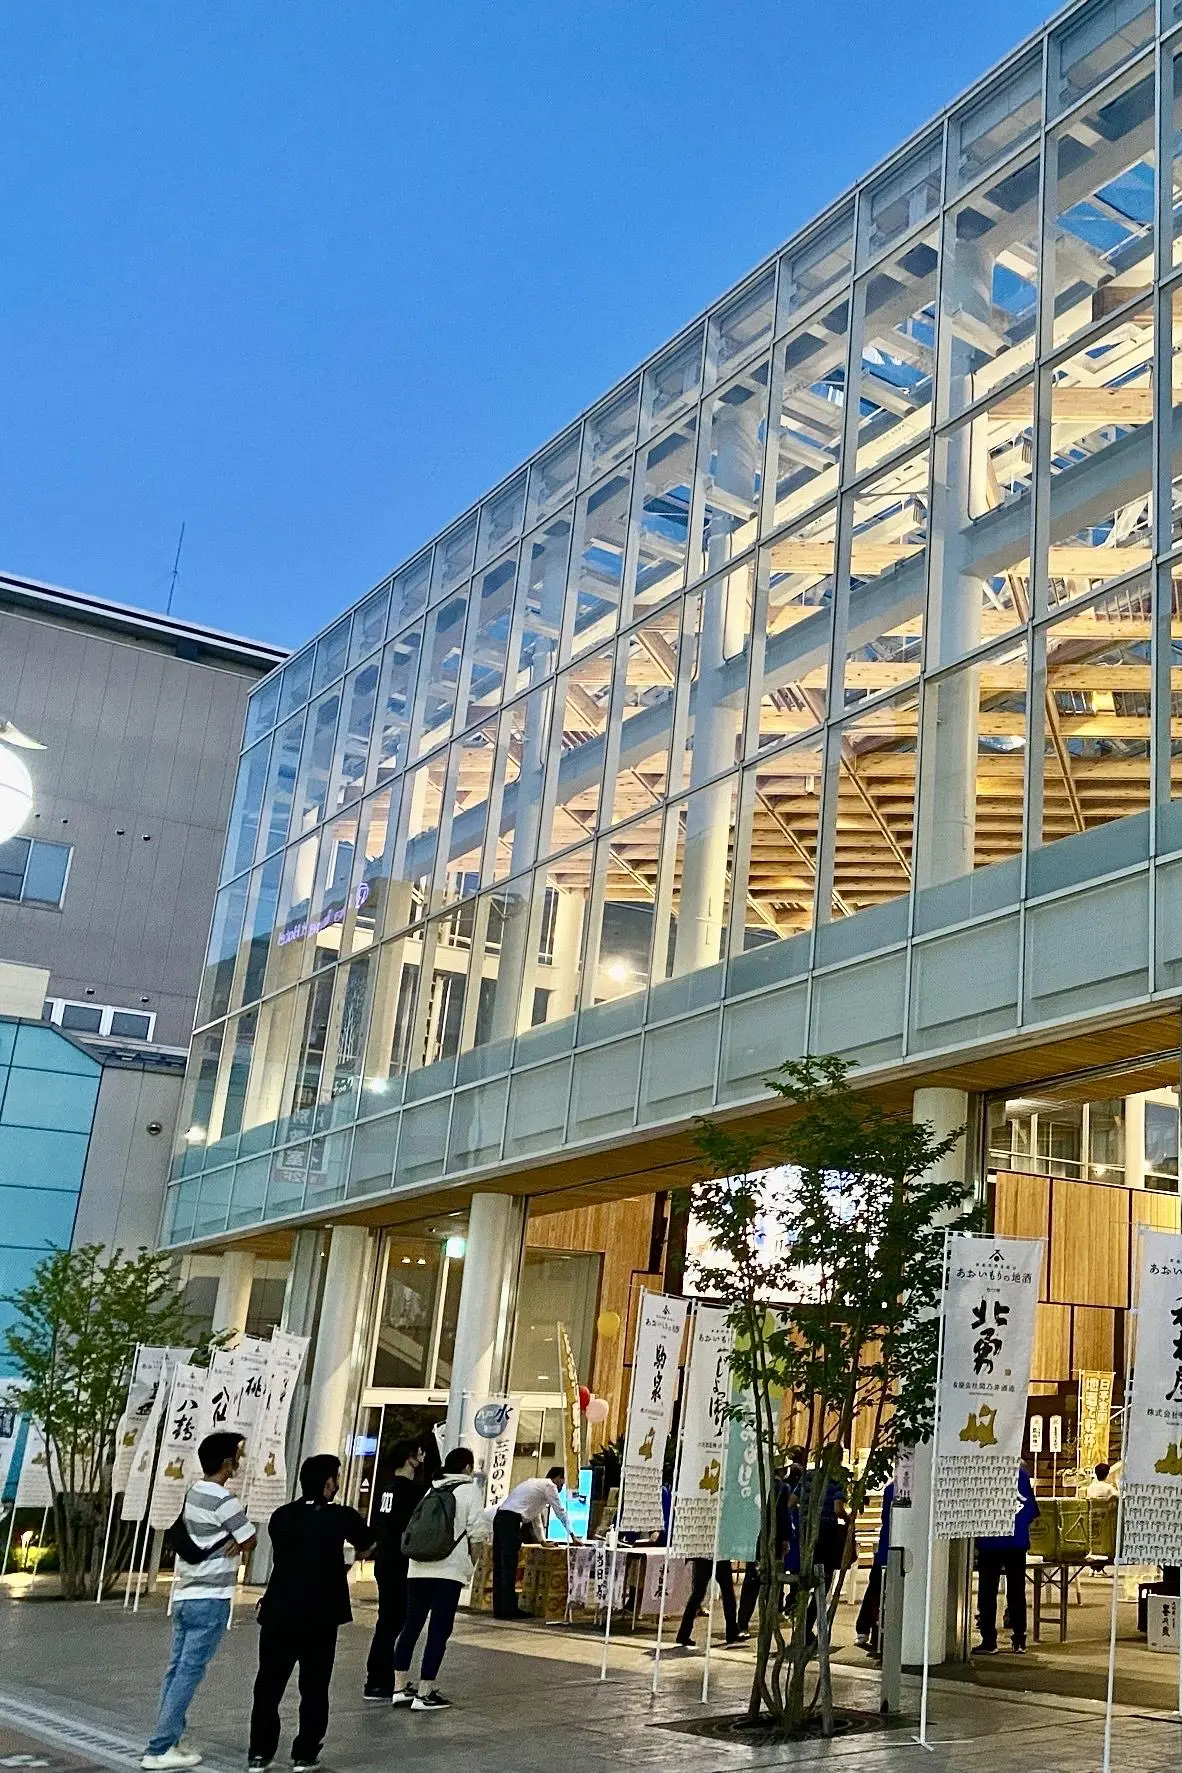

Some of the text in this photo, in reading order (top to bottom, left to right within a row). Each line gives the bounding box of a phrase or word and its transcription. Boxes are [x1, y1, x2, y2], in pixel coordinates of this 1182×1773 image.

[957, 1268, 1032, 1284] あおいもりの地酒
[971, 1297, 1010, 1375] 北勇
[495, 1404, 513, 1423] 水
